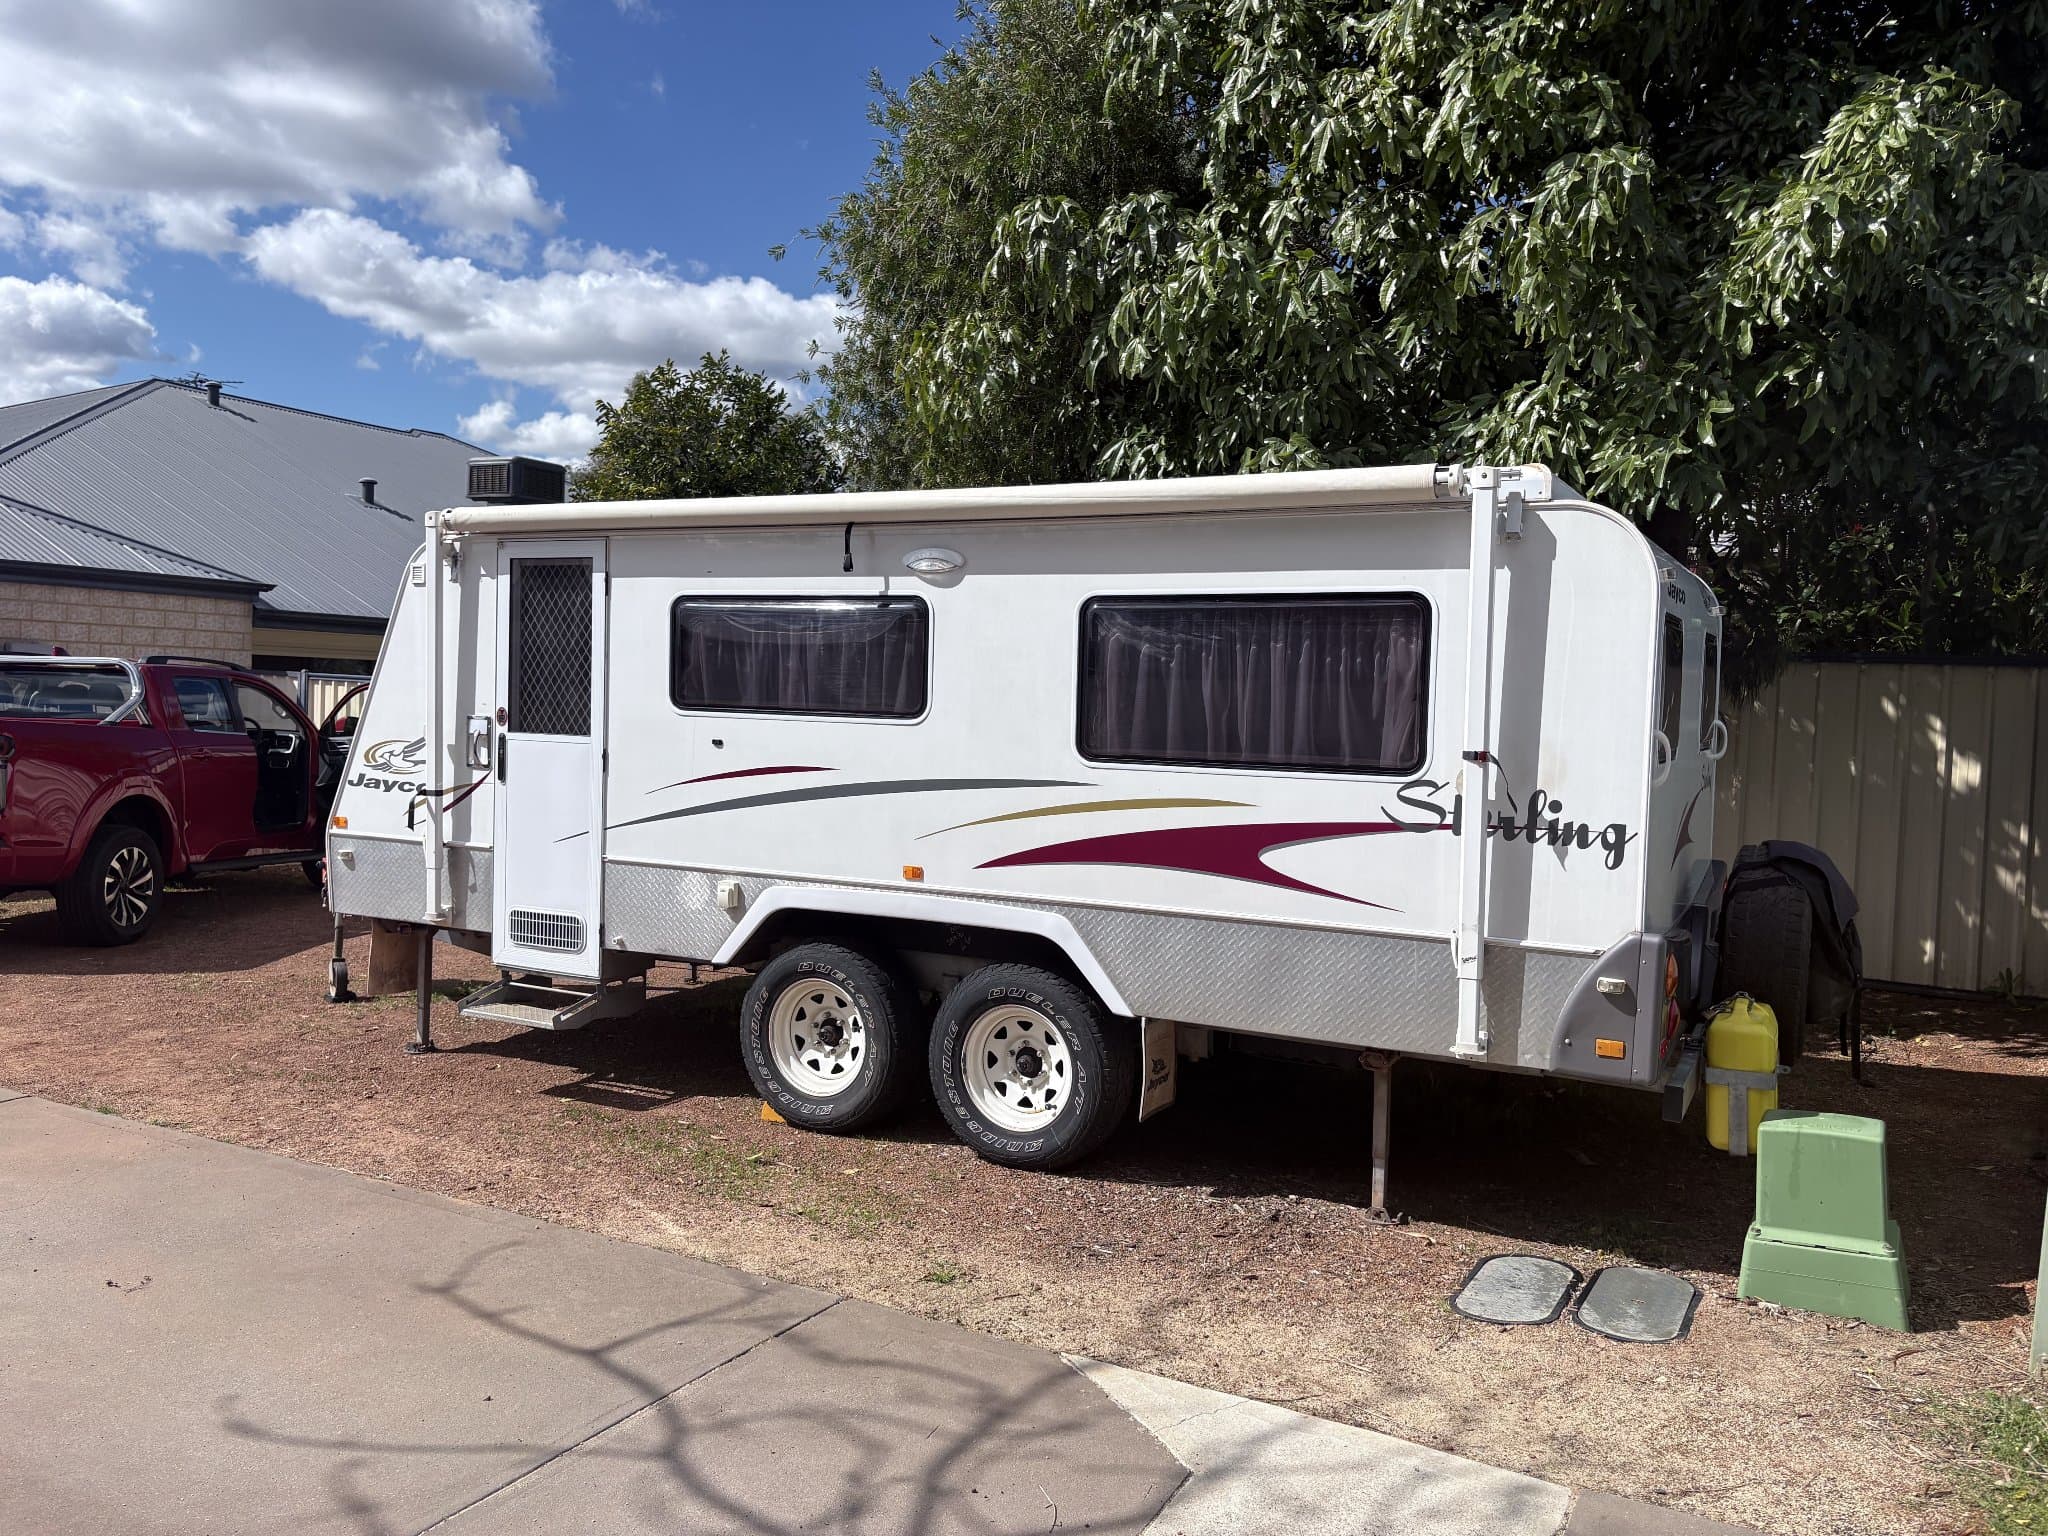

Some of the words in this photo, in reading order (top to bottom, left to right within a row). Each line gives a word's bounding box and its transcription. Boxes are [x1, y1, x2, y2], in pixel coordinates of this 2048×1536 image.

[751, 986, 835, 1116] BRIDGESTONE
[988, 987, 1081, 1051] DUELER
[942, 1020, 1044, 1152] BRIDGESTONE
